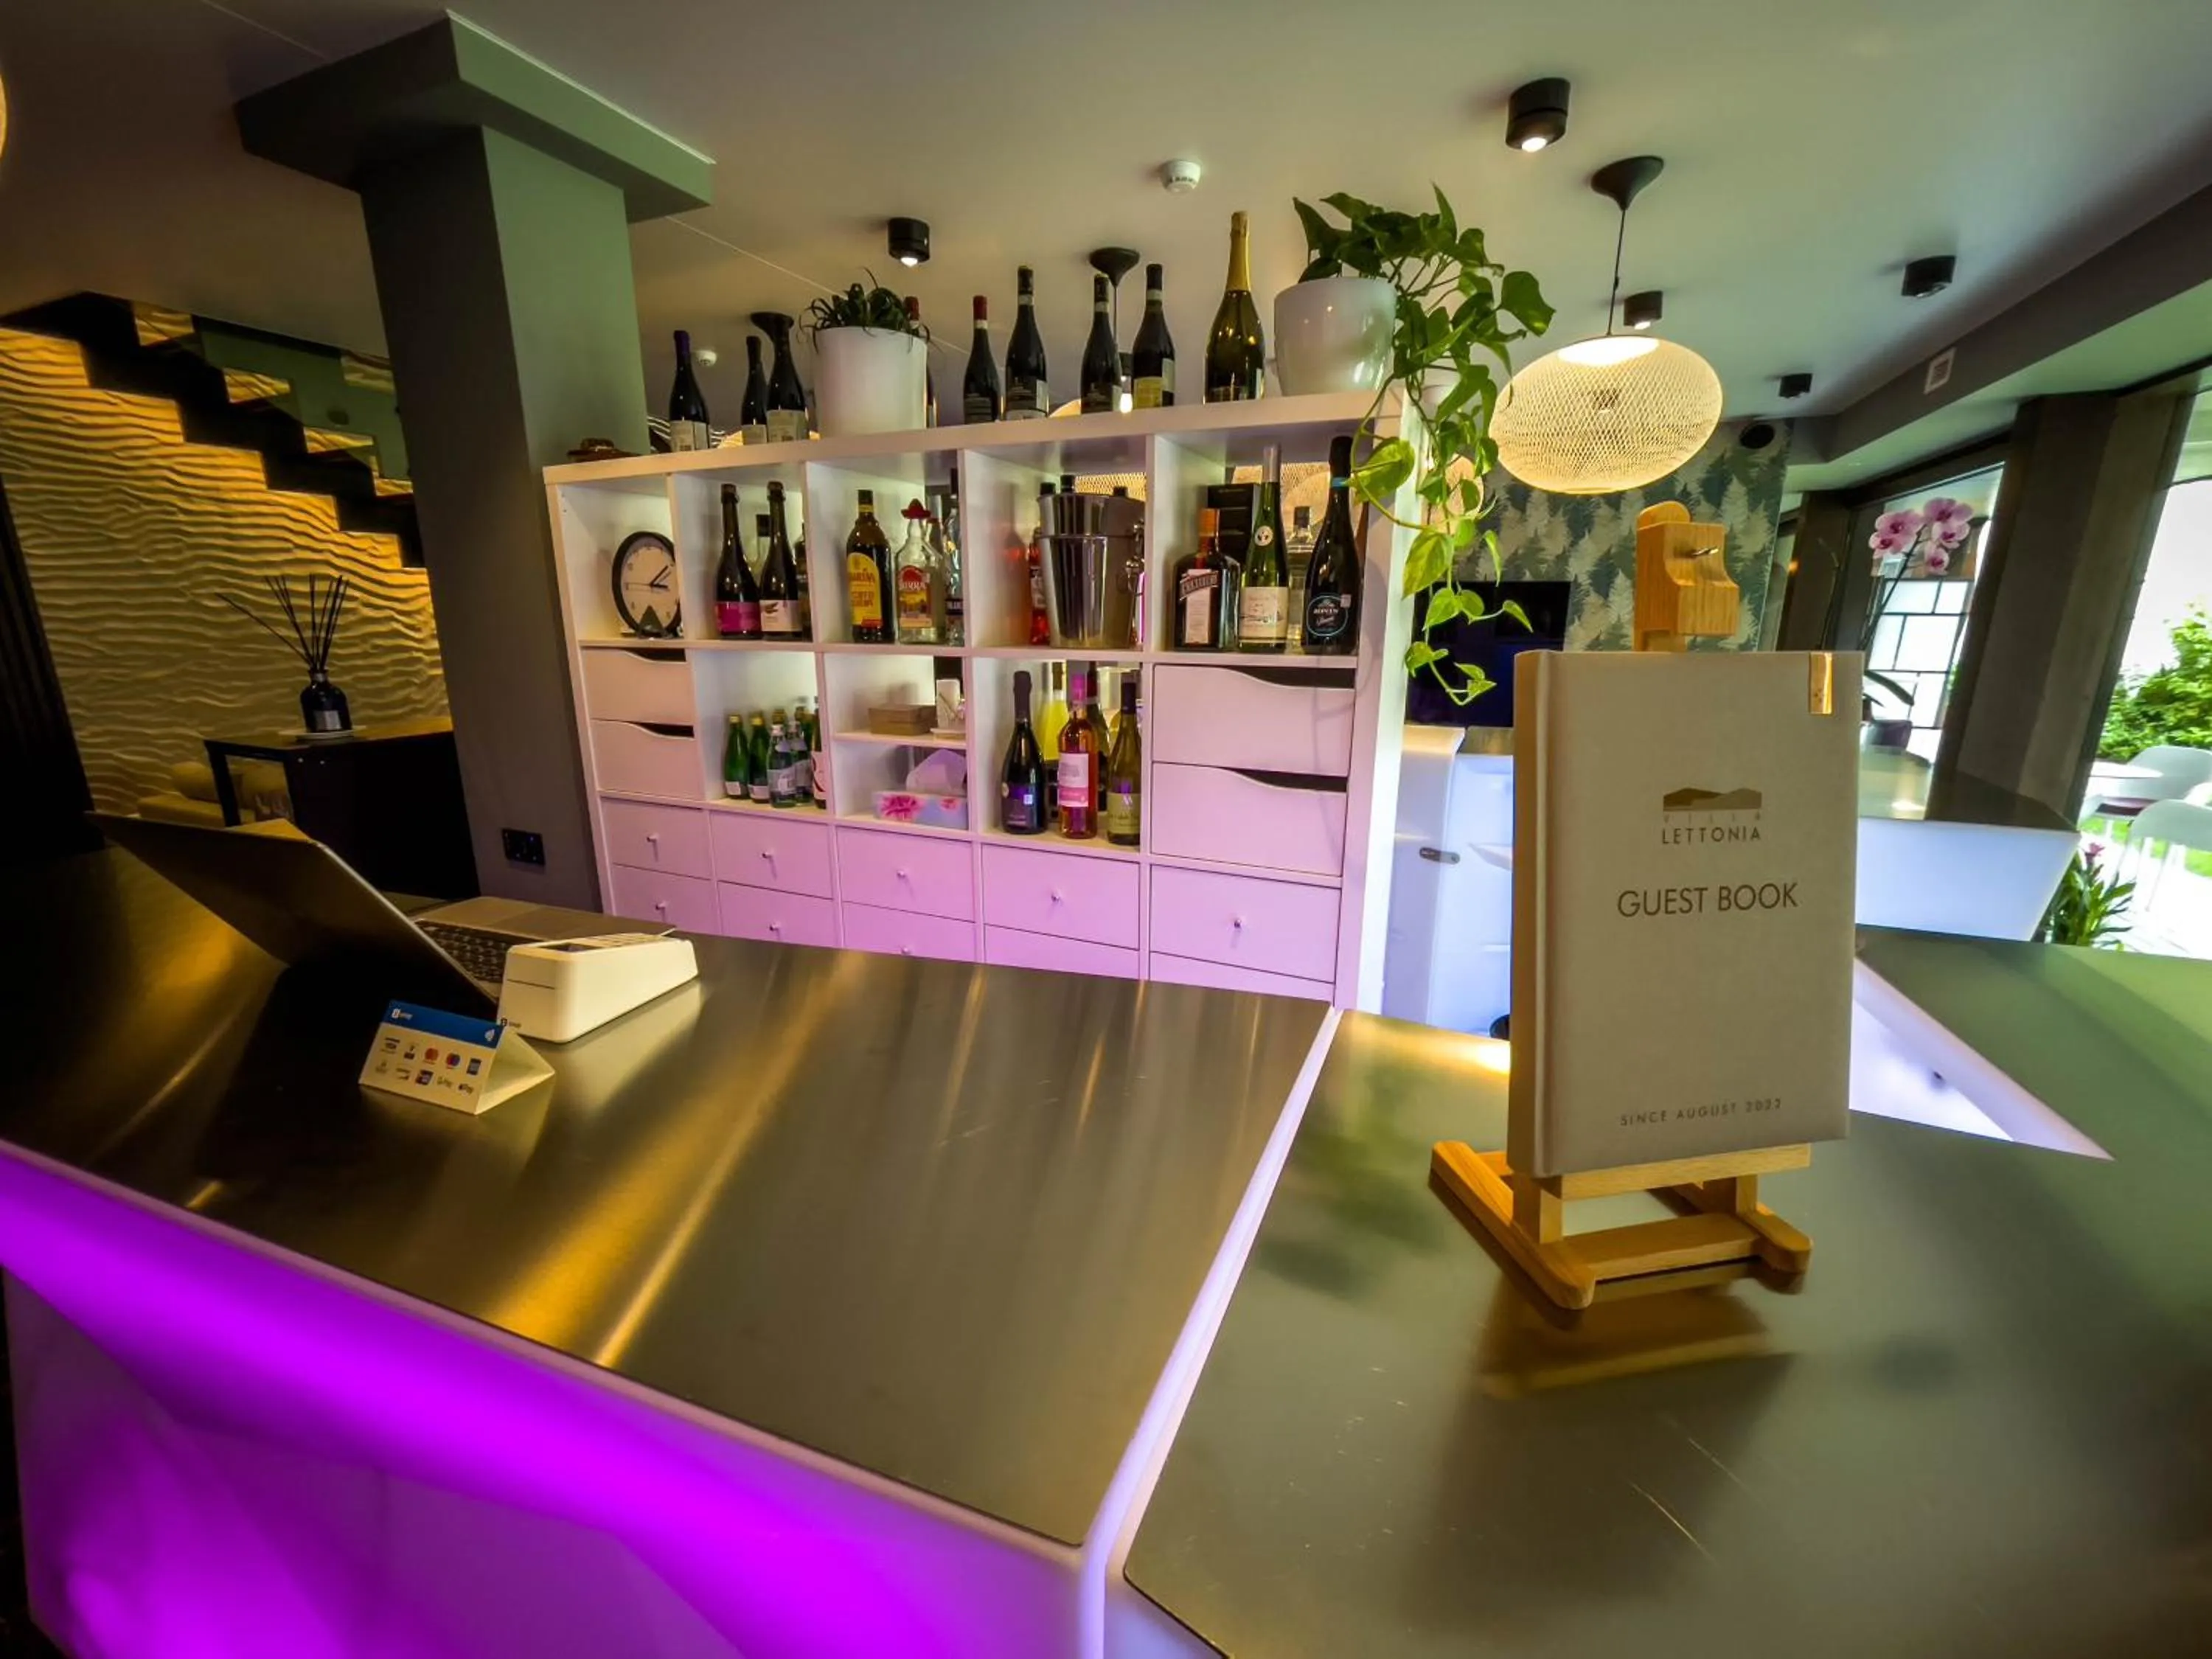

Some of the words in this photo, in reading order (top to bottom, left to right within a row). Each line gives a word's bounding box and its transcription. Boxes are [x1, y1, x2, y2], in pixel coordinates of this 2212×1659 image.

[1662, 826, 1761, 845] LETTONIA
[1617, 887, 1708, 917] GUEST
[1718, 882, 1798, 911] BOOK
[1620, 1110, 1667, 1127] SINCE
[1676, 1102, 1736, 1120] AUGUST
